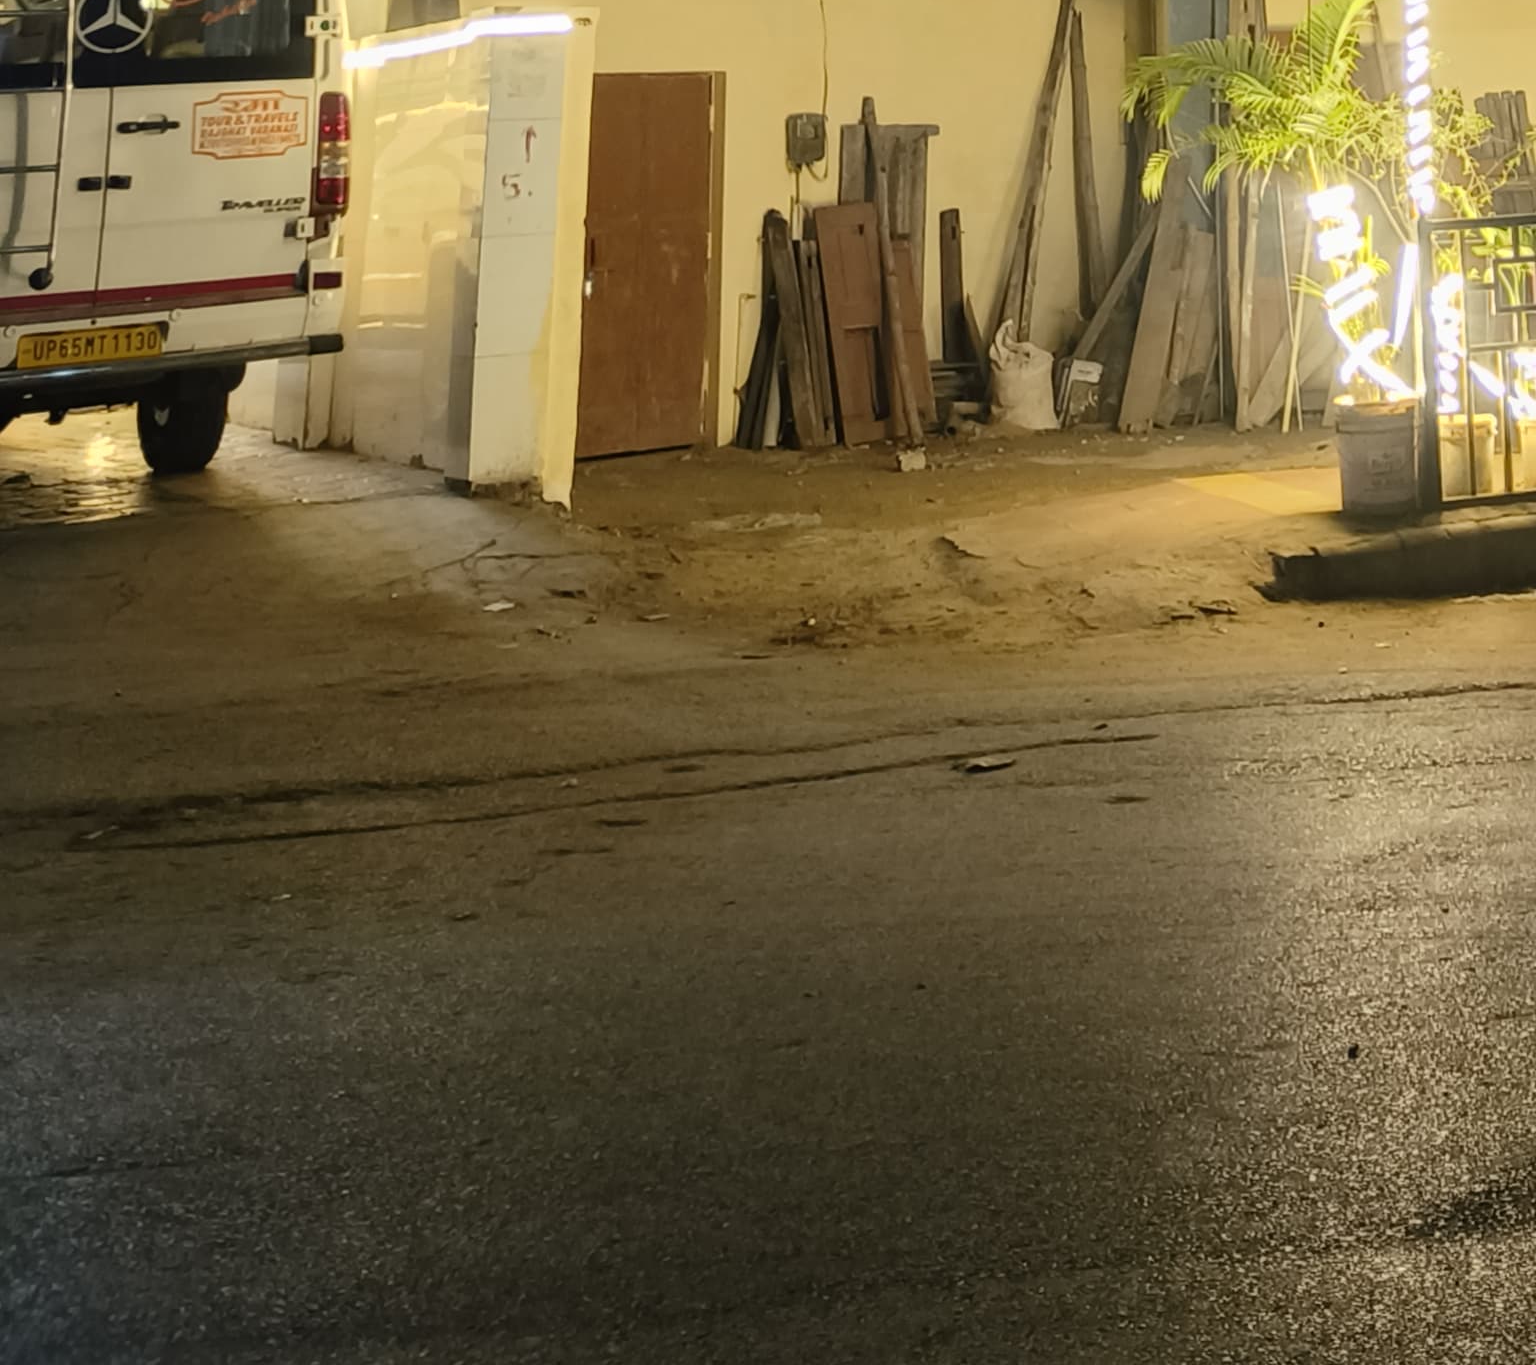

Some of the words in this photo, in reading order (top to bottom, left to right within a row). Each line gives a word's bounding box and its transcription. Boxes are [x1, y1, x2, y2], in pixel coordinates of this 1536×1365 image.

[201, 116, 232, 127] TOUR
[246, 111, 298, 124] TRAVELS
[32, 330, 158, 362] UP65MT1130
